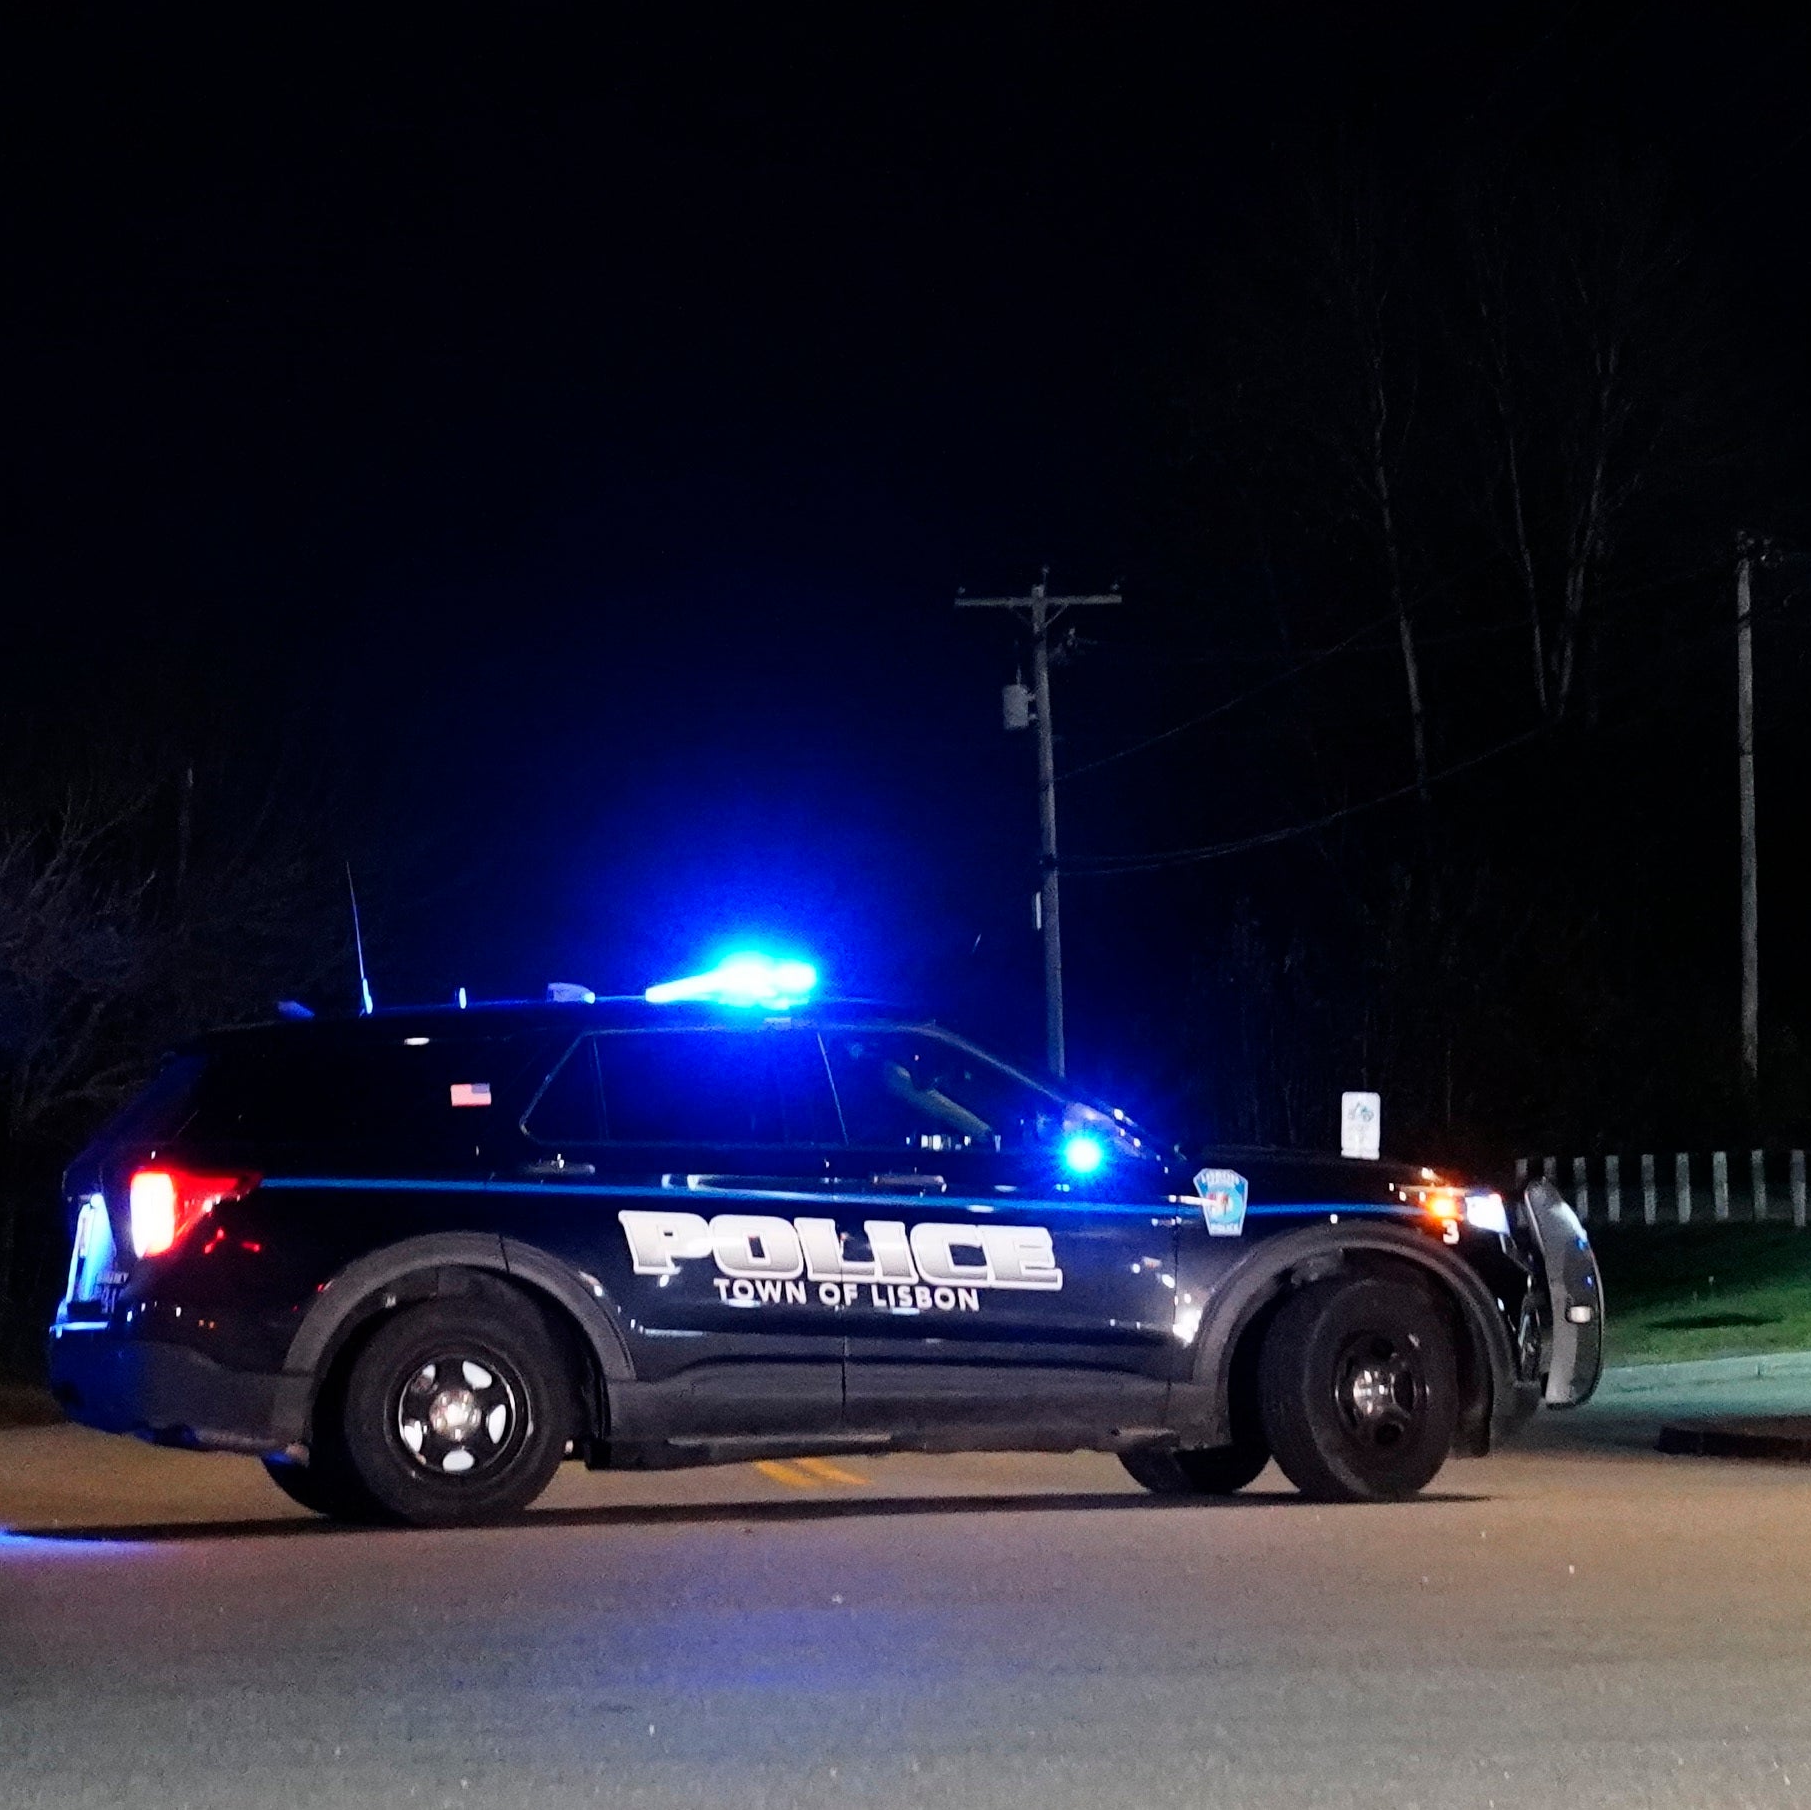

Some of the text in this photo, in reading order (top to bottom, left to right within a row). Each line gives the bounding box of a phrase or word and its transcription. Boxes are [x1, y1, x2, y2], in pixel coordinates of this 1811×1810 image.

[1442, 1218, 1460, 1244] 3
[618, 1209, 1064, 1290] POLICE
[713, 1278, 981, 1313] TOWN OF LISBON
